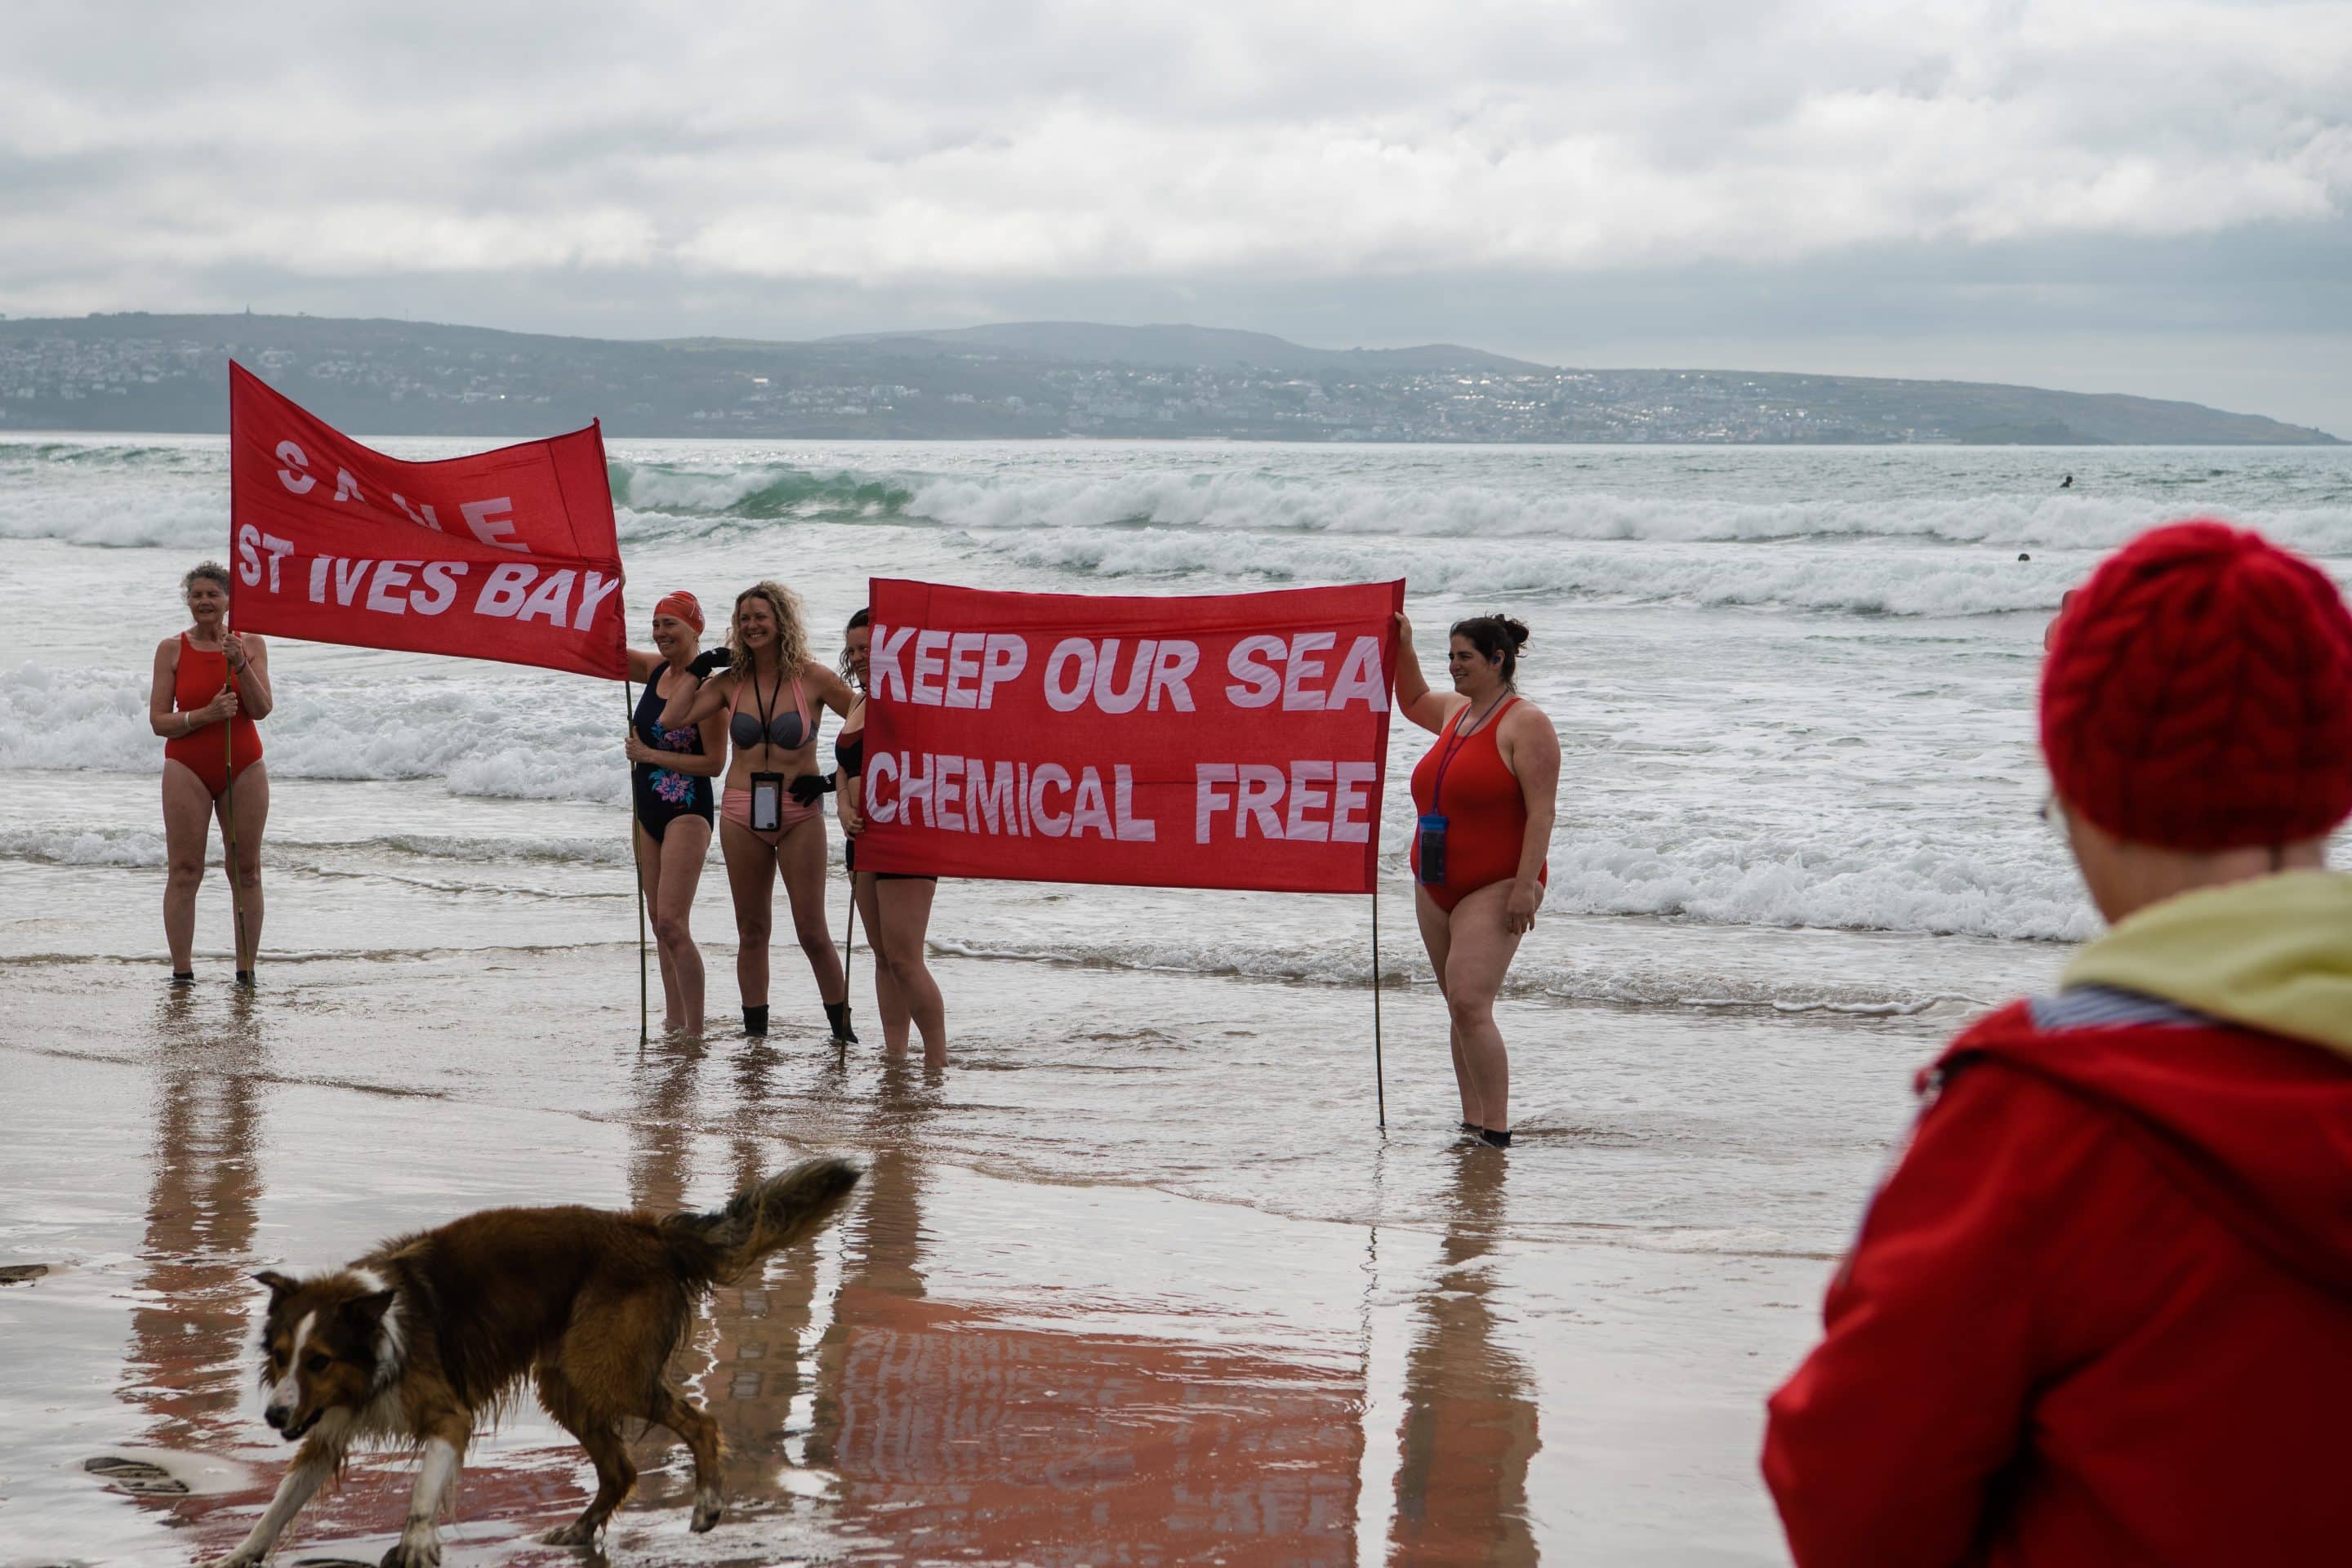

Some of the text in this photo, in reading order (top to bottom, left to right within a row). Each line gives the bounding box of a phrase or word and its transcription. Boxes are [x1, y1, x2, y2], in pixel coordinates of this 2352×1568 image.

[238, 523, 620, 632] ST IVES BAY
[870, 624, 1389, 715] KEEP OUR SEA
[865, 751, 1377, 844] CHEMICAL FREE
